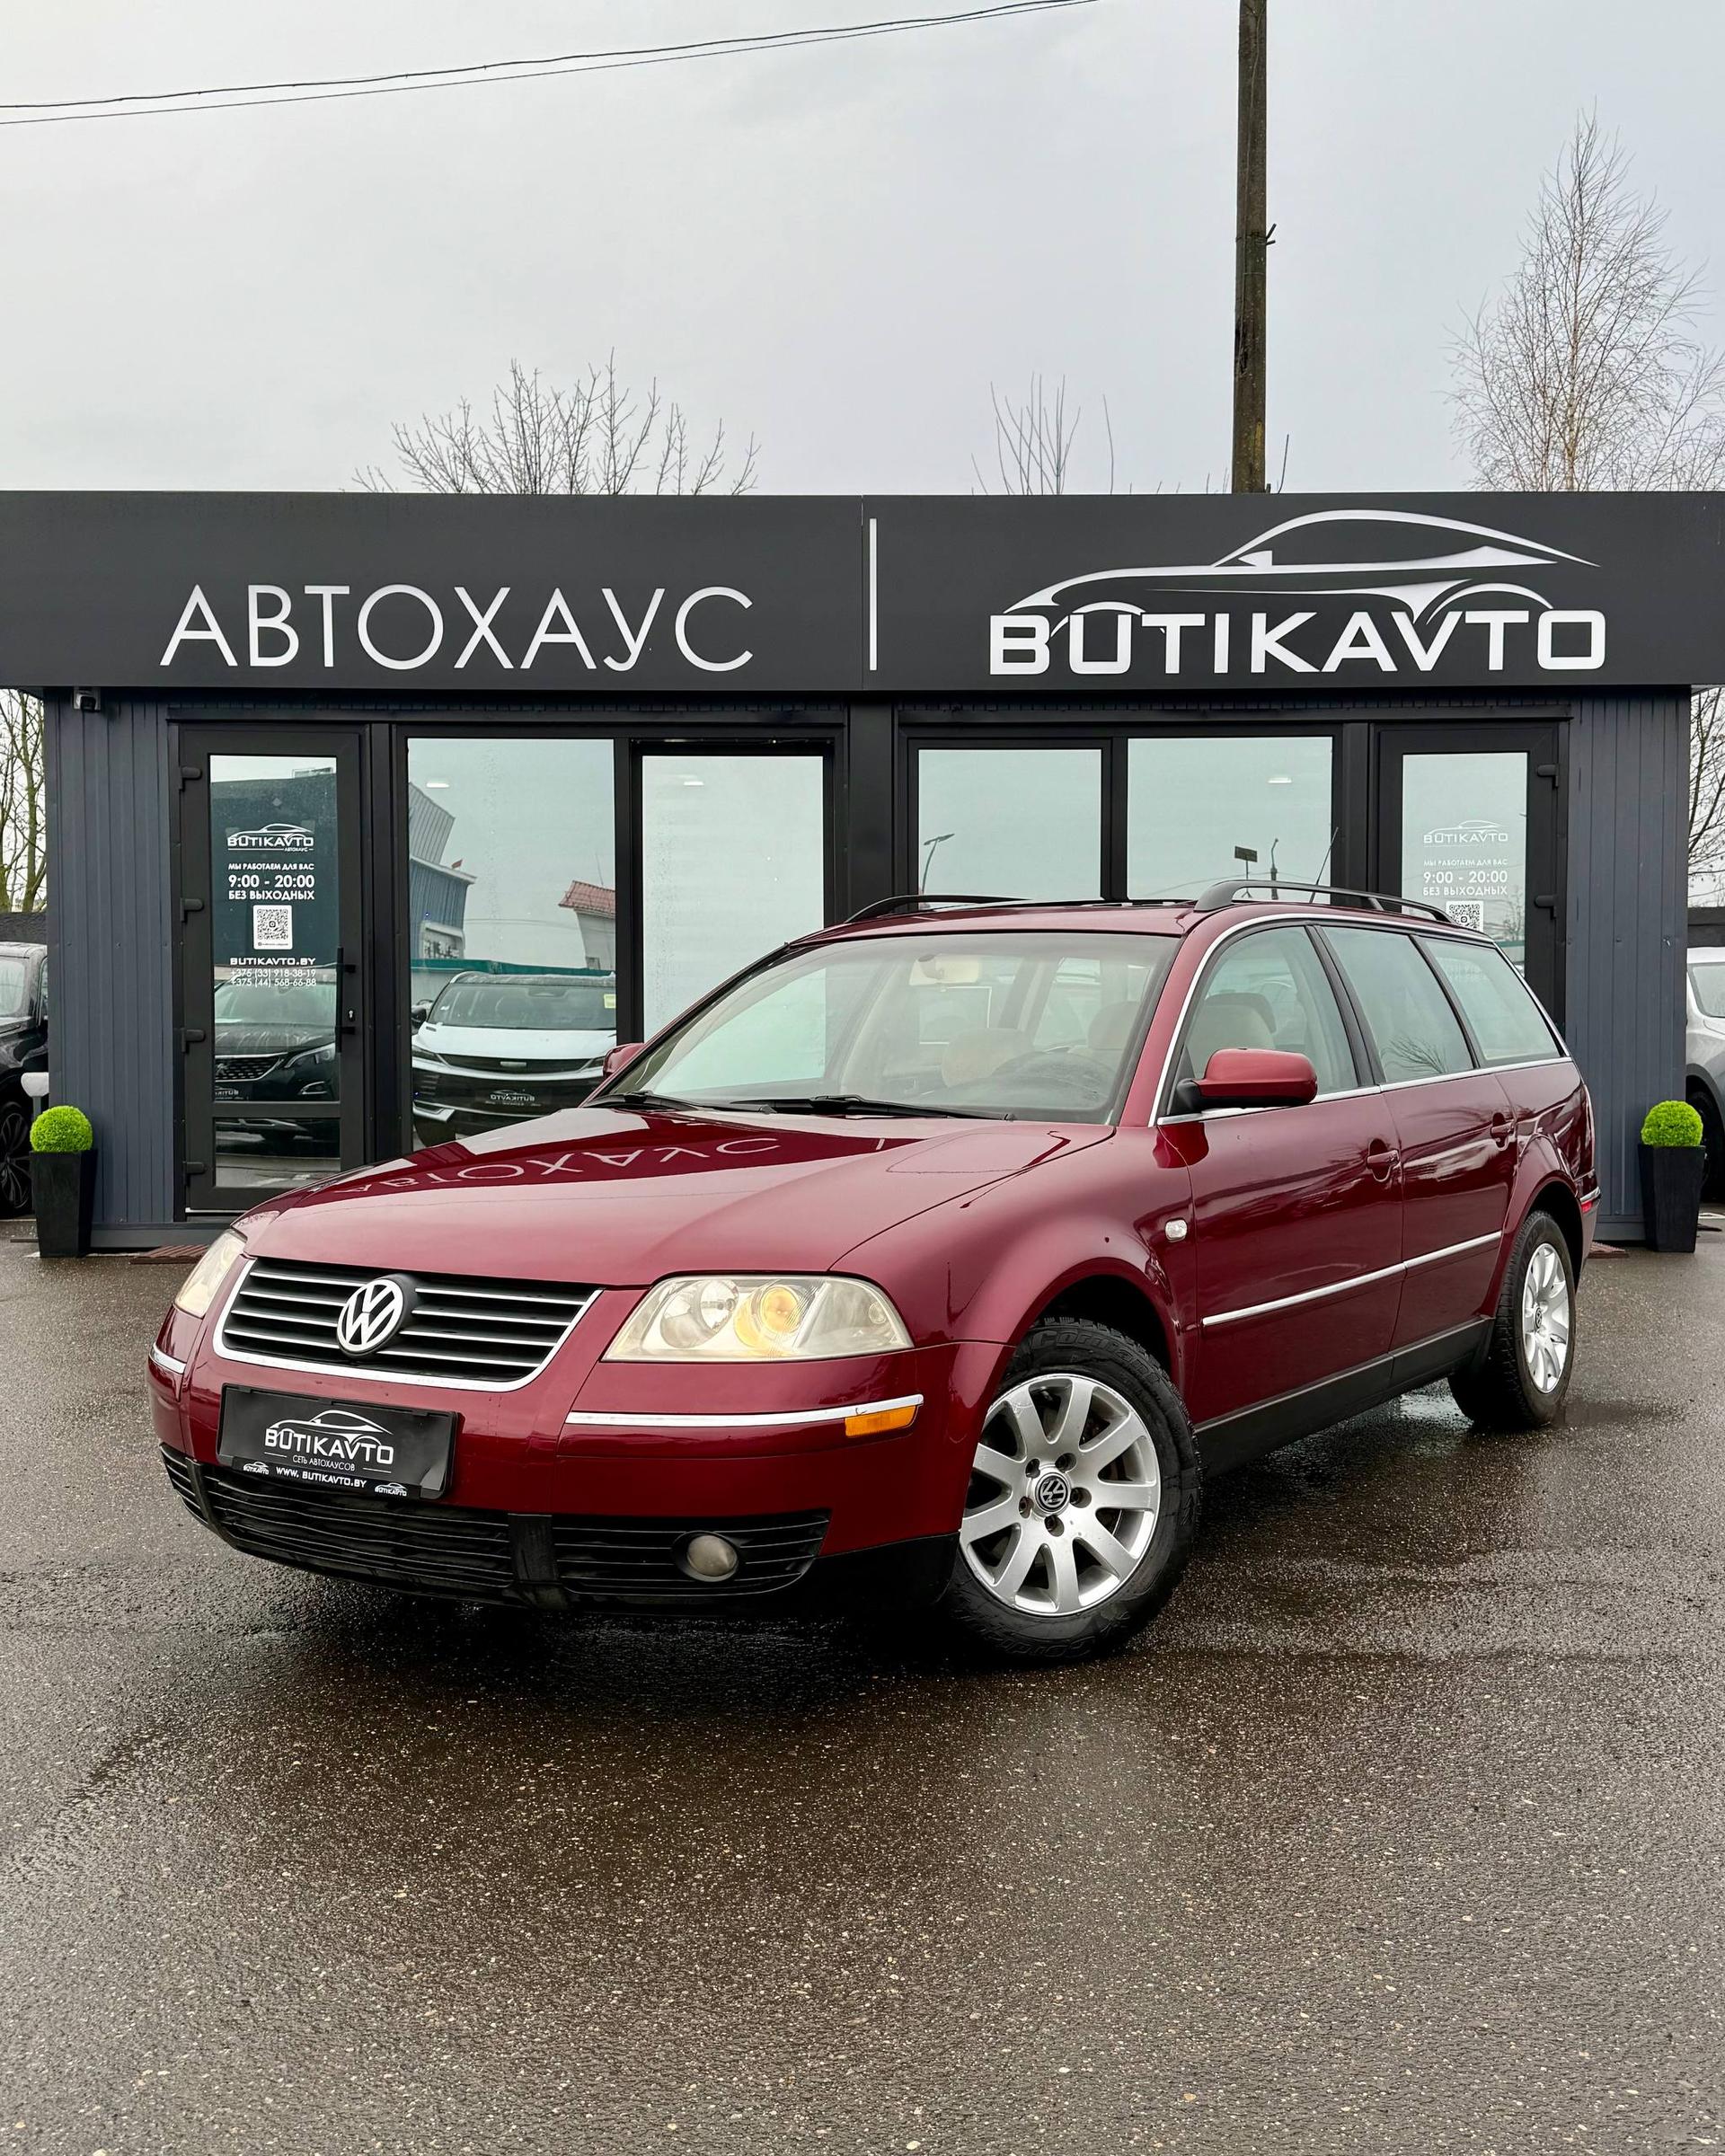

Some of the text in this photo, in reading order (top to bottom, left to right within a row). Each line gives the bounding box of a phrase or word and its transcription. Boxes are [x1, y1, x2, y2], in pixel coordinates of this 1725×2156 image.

[159, 583, 754, 672] АВТОХАУС
[989, 609, 1606, 676] BUTIKAVTO
[227, 836, 314, 847] BUTIKAVTO
[1423, 833, 1508, 844] BUTIKAVTO
[282, 863, 297, 871] ДЛЯ
[228, 875, 260, 888] 9:00
[274, 874, 314, 888] 20:00
[1423, 871, 1453, 884] 9:00
[1469, 870, 1508, 883] 20:00
[228, 890, 314, 900] БЕЗ ВЫХОДНЫХ
[1423, 886, 1508, 897] БЕЗ ВЫХОДНЫХ
[230, 958, 316, 966] BUTIKAVTO.BY
[230, 968, 316, 979] +375 (33) 918-38-19
[230, 977, 317, 988] +375 (44) 568-66-88
[264, 1427, 394, 1465] BUTIKAVTO
[292, 1454, 356, 1471] СЕТЬ АВТОХАУСОВ
[243, 1465, 270, 1475] BUTIKAVTO
[276, 1466, 367, 1489] WWW. BUTIKAVTO.BY
[375, 1487, 407, 1497] BUTIKAVTO
